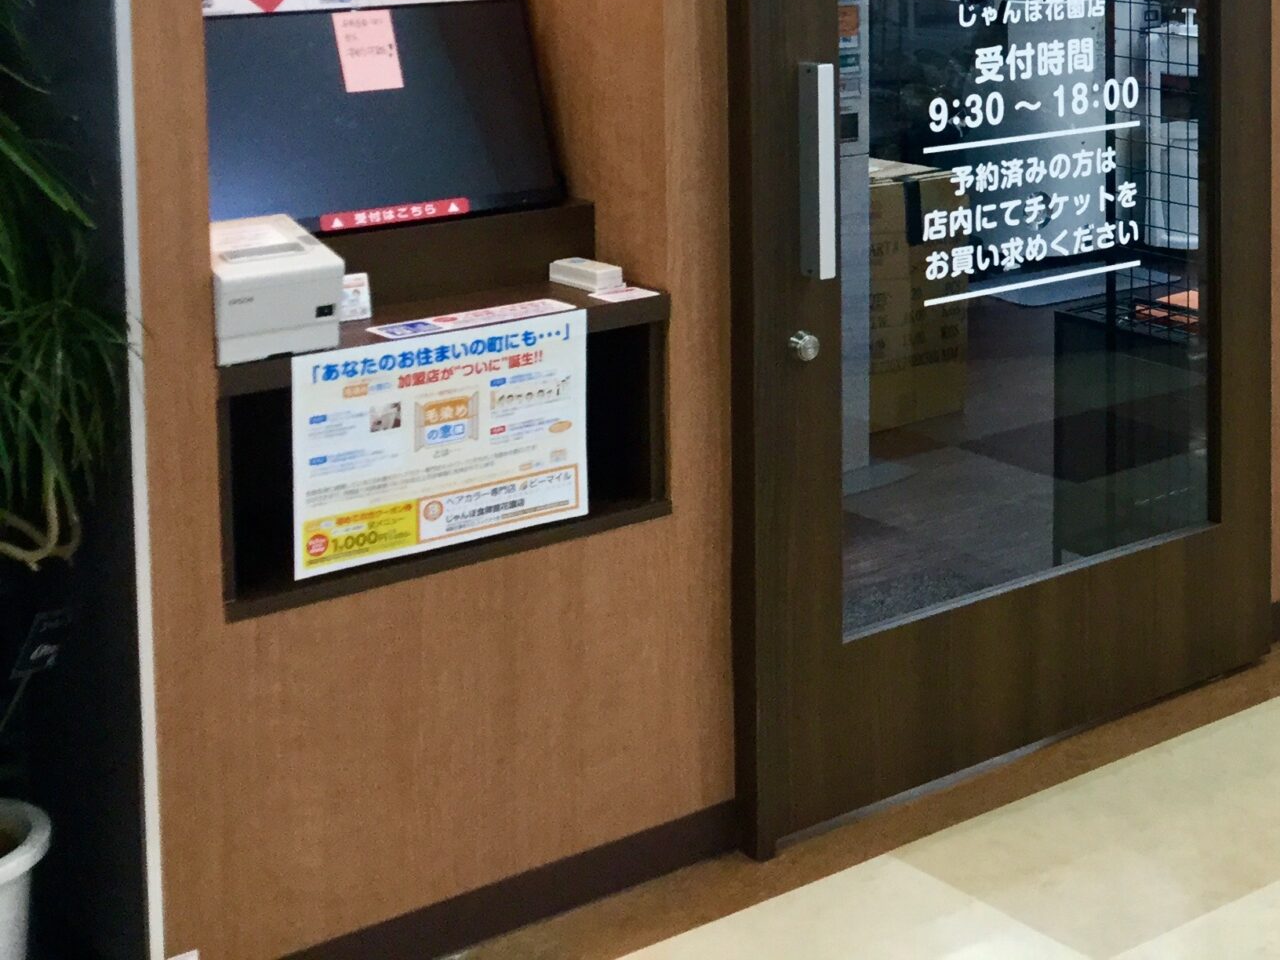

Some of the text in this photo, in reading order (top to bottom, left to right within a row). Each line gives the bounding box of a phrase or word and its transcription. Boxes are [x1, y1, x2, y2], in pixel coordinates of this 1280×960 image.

[975, 37, 1094, 84] 受付時間
[929, 92, 1005, 133] 9:30
[1053, 77, 1139, 117] 18:00
[950, 145, 1117, 196] 予約済みの方は
[354, 202, 437, 225] 受付はこちら
[922, 181, 1138, 242] 店内にてチケットを
[925, 220, 1139, 281] お買い求めください
[424, 398, 468, 422] 毛染め
